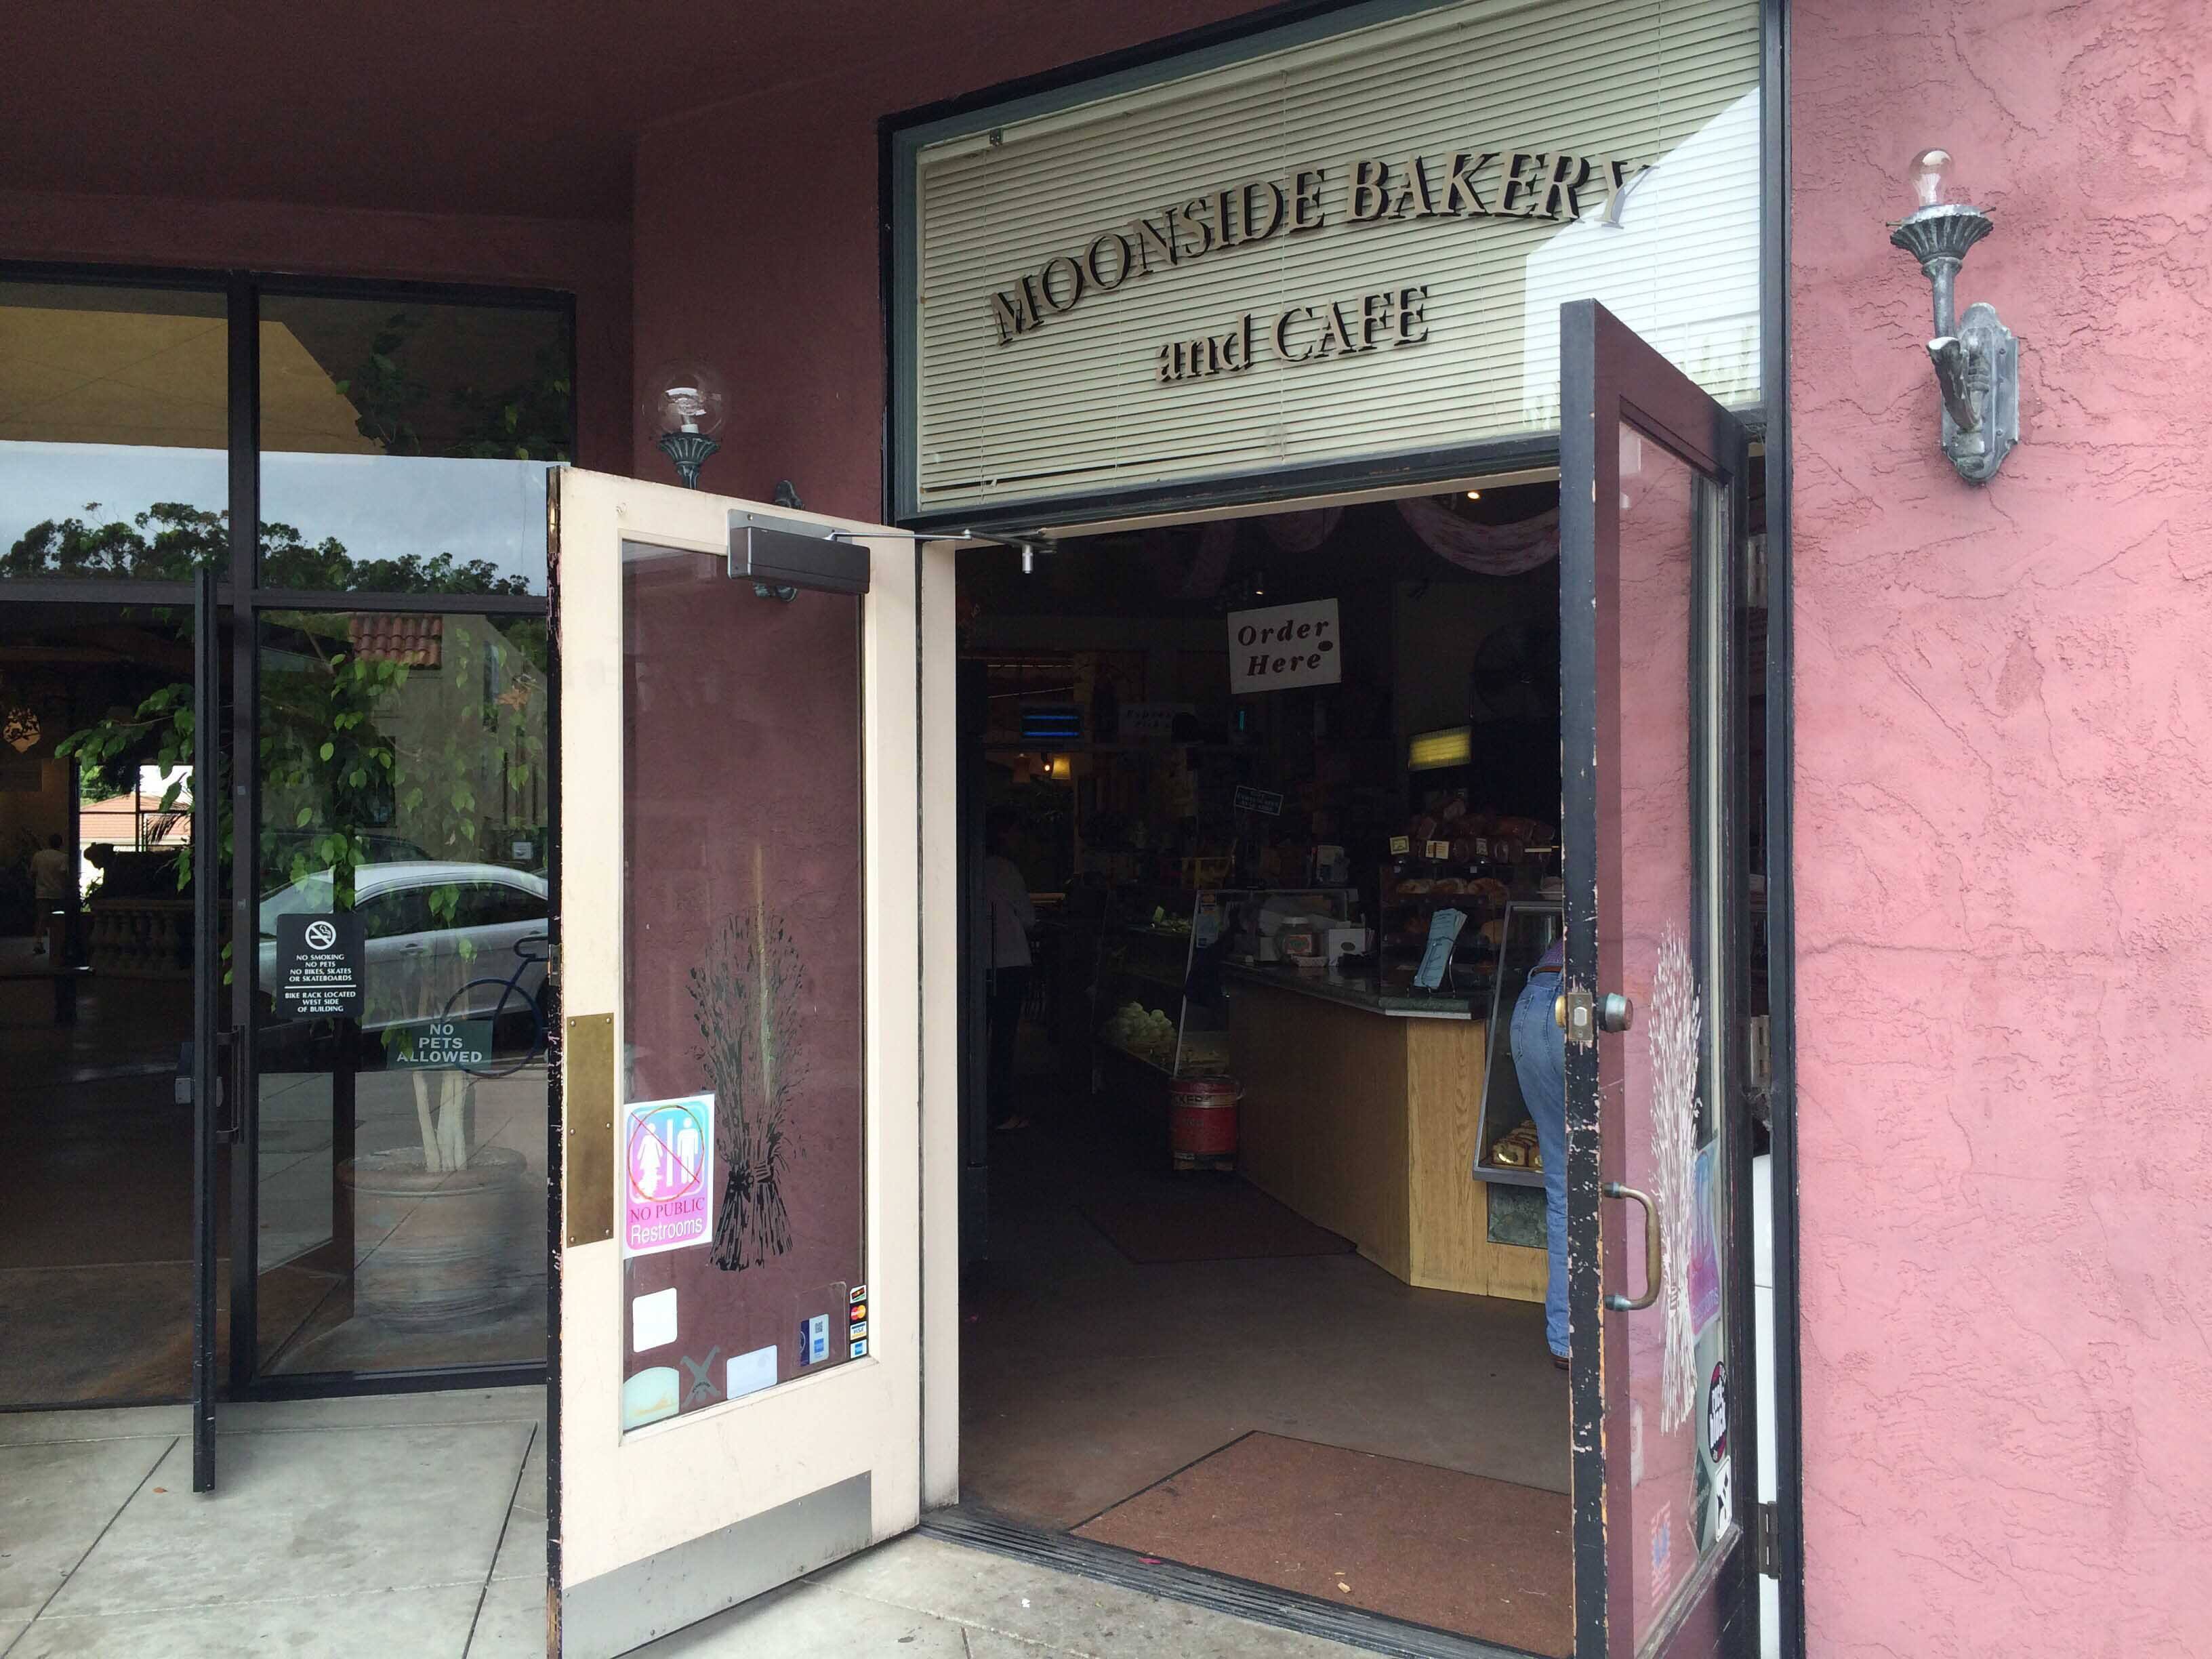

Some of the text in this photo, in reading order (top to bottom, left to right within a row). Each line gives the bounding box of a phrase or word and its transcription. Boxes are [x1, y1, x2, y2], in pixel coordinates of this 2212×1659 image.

[989, 150, 1660, 348] MOONSIDE BAKERY
[1156, 284, 1430, 384] and CAFE
[1237, 619, 1329, 646] Order
[1247, 653, 1321, 676] Here
[418, 1038, 463, 1048] PETS
[430, 1024, 454, 1036] NO
[396, 1051, 482, 1063] ALLOWED
[630, 1197, 704, 1223] NO PUBLIC
[631, 1218, 703, 1246] Restrooms
